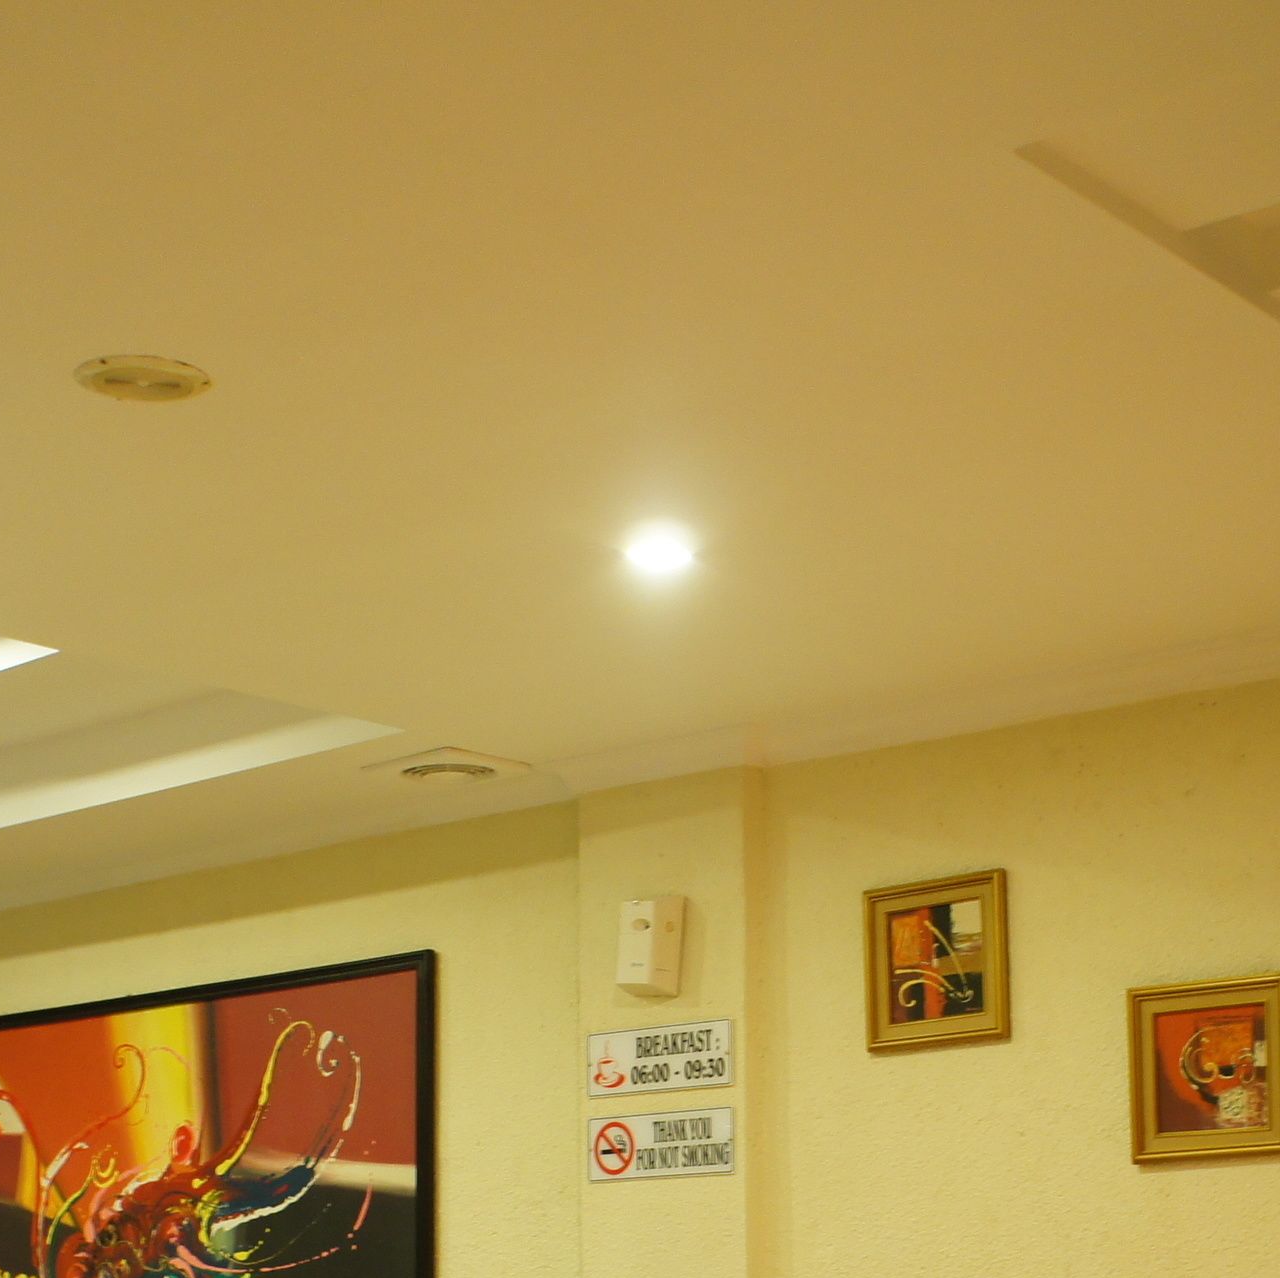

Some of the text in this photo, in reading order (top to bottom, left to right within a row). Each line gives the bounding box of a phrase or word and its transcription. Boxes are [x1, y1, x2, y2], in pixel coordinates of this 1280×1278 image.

[635, 1029, 713, 1059] BREAKFAST
[630, 1062, 670, 1085] 06:00
[684, 1057, 725, 1080] 09:30
[652, 1117, 713, 1143] THANK YOU
[636, 1142, 730, 1170] FOR NOT SMOKING
